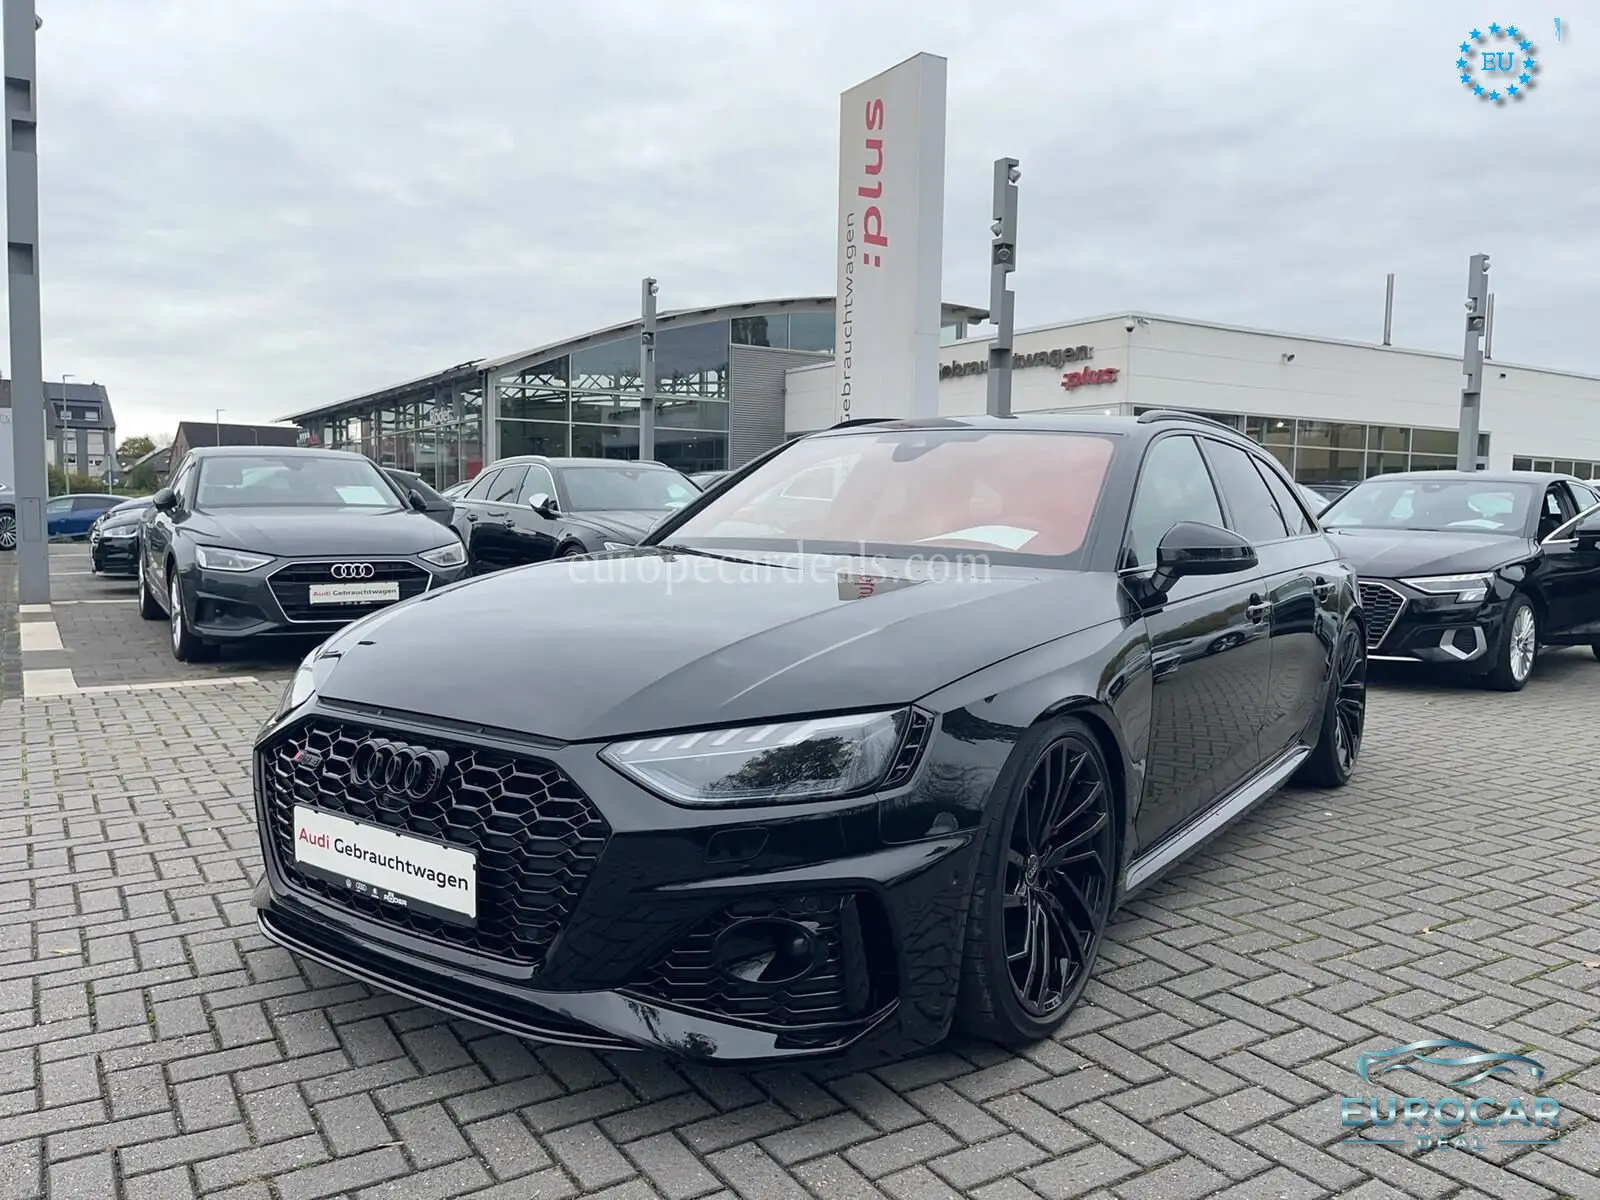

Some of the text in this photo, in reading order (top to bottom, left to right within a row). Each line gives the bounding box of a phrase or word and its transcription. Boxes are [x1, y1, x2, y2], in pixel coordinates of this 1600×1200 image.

[332, 588, 397, 597] Gebrauchtwagen
[299, 828, 469, 890] Audi Gebrauchtwagen
